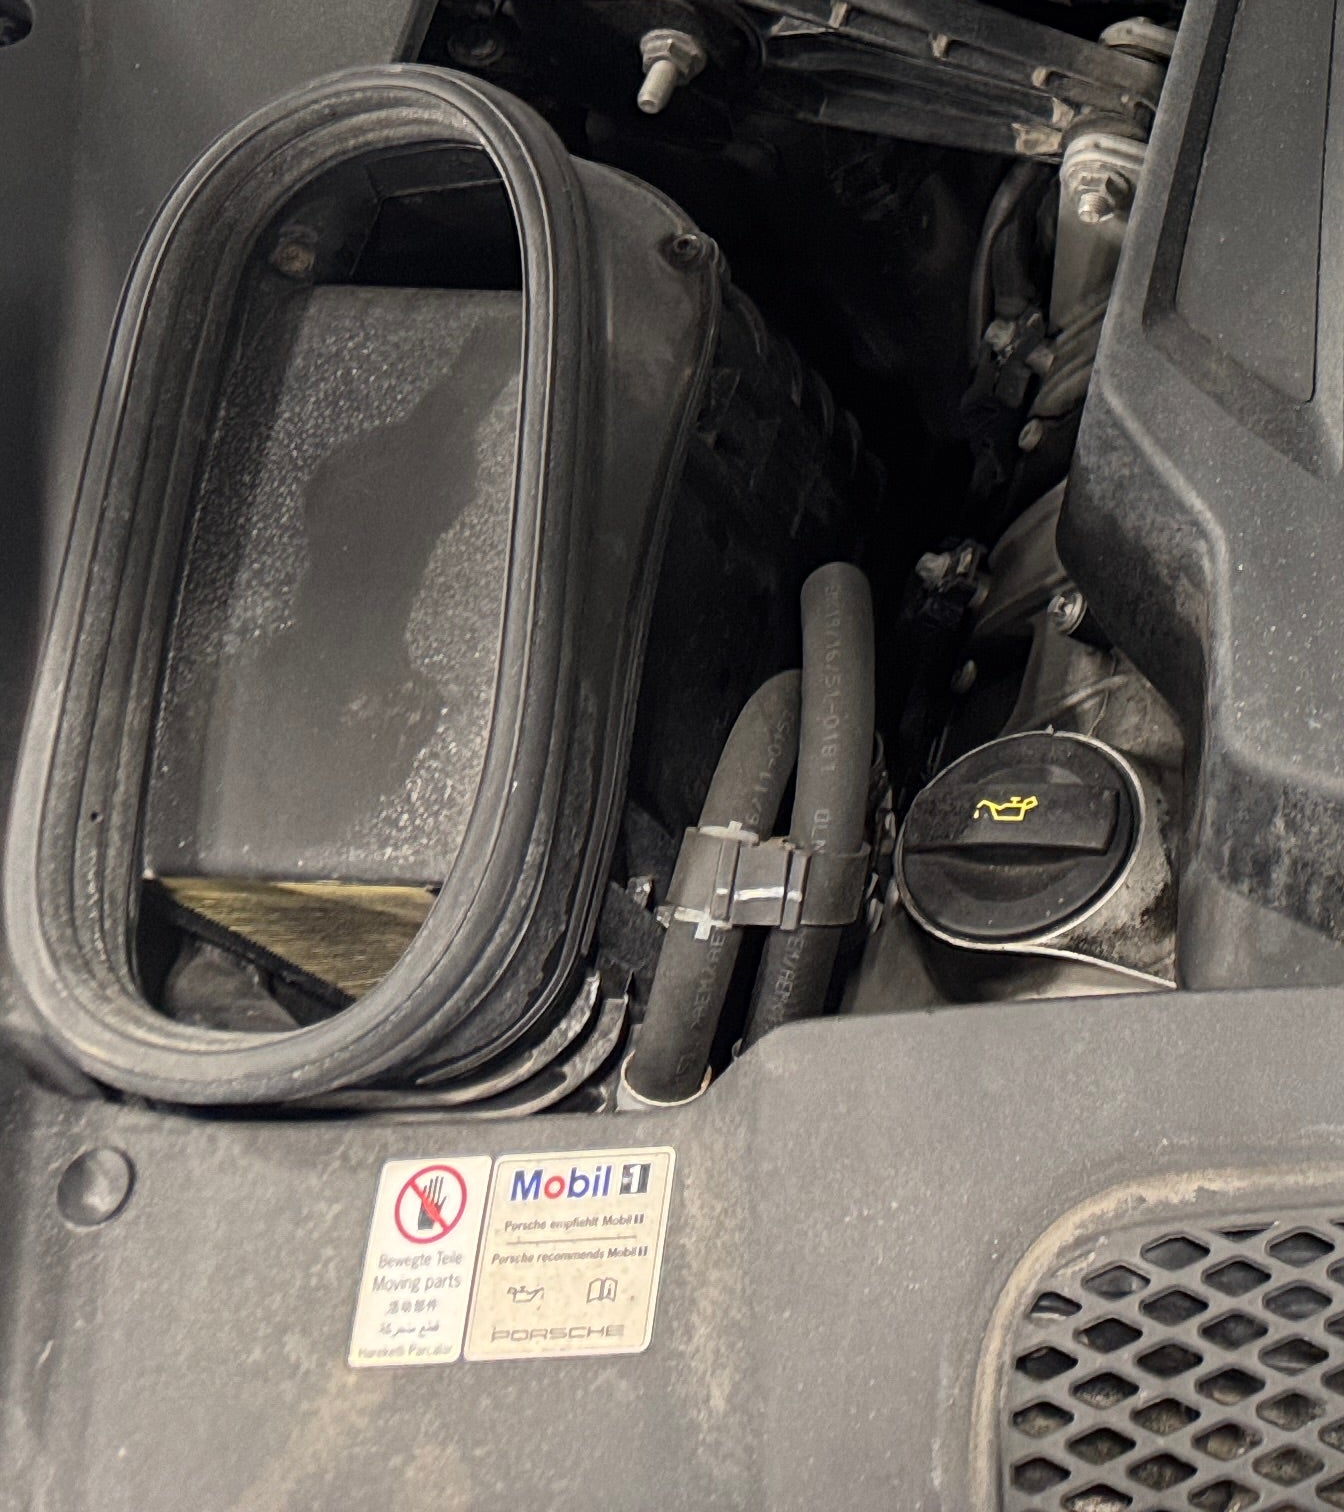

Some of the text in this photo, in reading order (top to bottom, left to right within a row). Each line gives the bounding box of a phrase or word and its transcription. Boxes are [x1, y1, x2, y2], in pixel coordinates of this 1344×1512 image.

[510, 1163, 649, 1201] Mobil 1
[504, 1218, 547, 1232] Porsche
[378, 1252, 432, 1271] Bewegte
[491, 1250, 535, 1265] Porsche
[372, 1272, 462, 1293] Moving parts
[490, 1324, 625, 1343] PORSCHE
